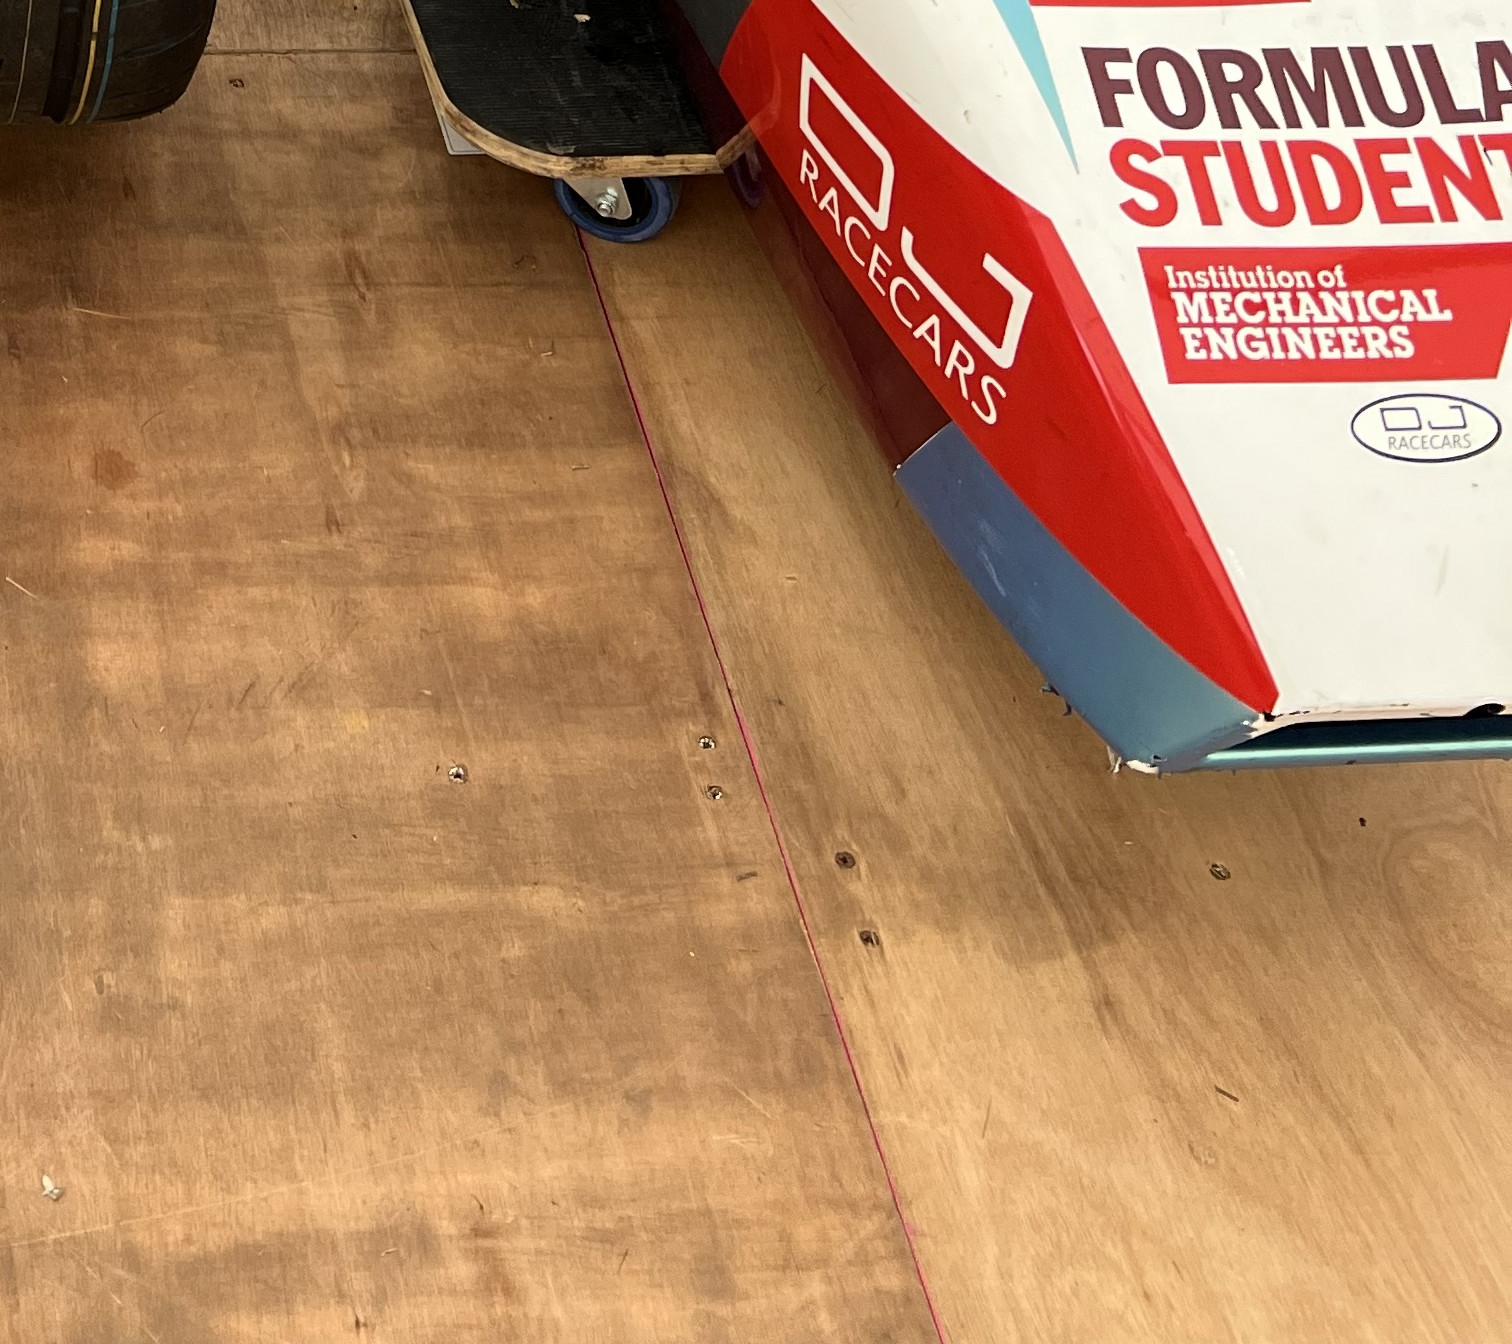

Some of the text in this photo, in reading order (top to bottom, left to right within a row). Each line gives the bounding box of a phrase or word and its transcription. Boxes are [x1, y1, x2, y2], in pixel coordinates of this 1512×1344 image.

[1080, 39, 1512, 131] FORMULA
[789, 148, 1007, 425] RACECARS
[1163, 264, 1348, 290] Institution of
[1170, 288, 1454, 325] MECHANICAL
[1178, 325, 1416, 361] ENGINEERS
[1379, 404, 1468, 432] DJ
[1386, 433, 1472, 451] RACECARS
